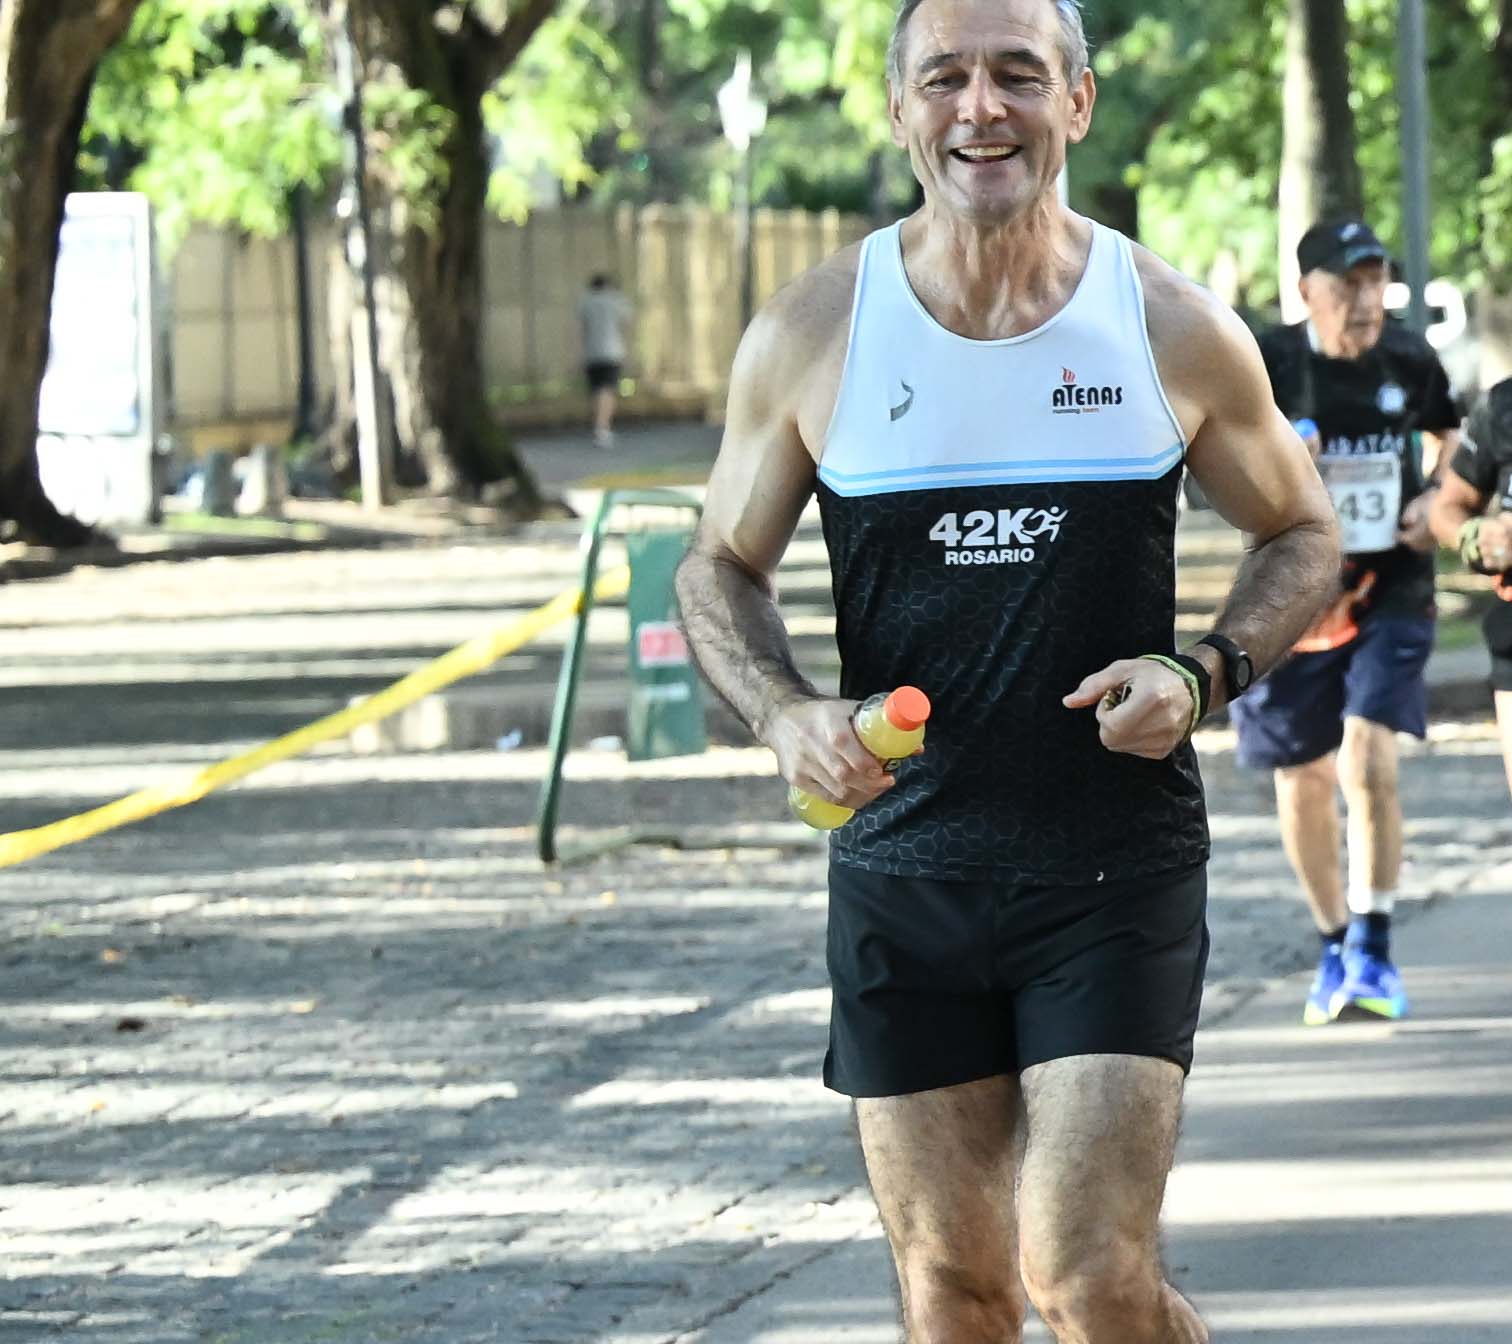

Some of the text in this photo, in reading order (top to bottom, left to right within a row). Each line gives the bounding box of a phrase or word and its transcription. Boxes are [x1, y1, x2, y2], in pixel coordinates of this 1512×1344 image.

[1052, 384, 1123, 407] ATENAS
[1337, 490, 1386, 522] 43
[929, 508, 1036, 547] 42K
[945, 548, 1035, 566] ROSARIO
